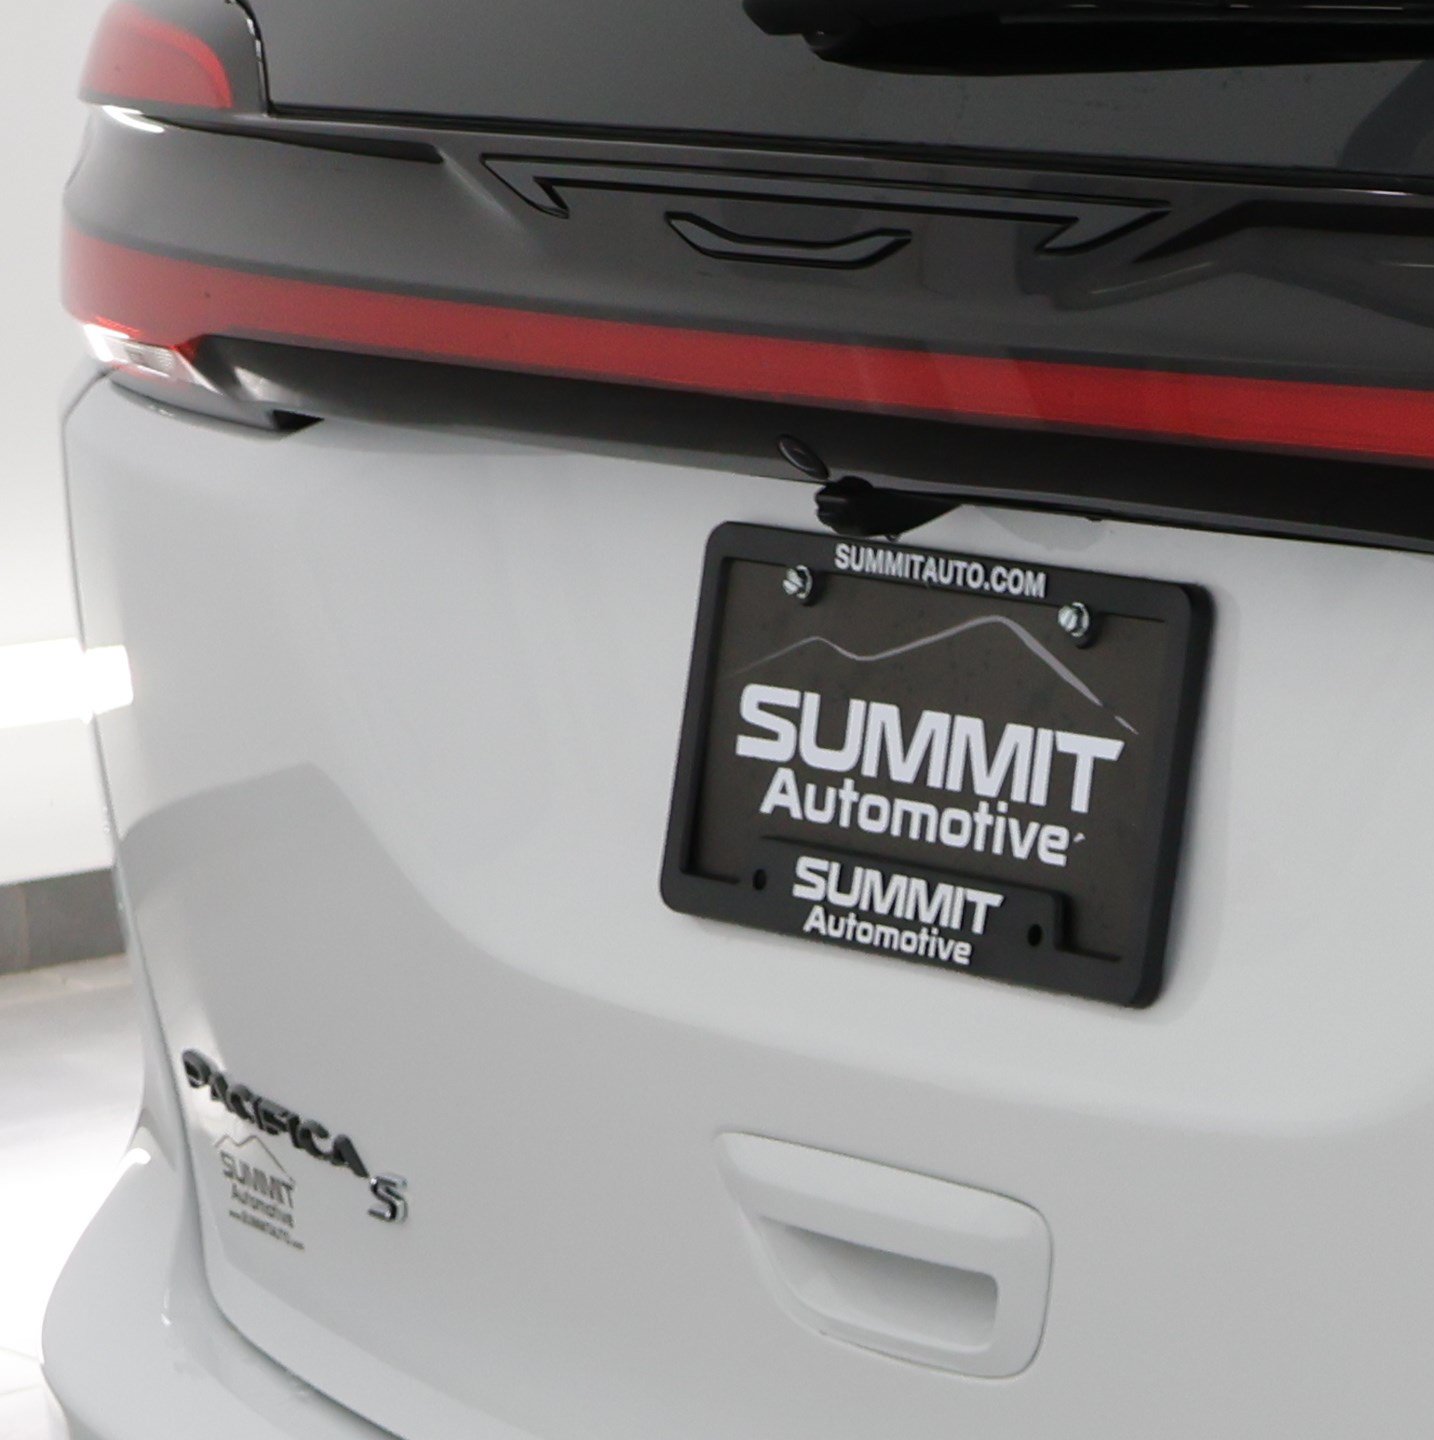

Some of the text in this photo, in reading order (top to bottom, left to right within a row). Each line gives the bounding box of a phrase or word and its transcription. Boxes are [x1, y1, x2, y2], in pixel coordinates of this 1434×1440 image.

[834, 542, 1046, 598] SUMMITAUTO.COM
[735, 683, 1125, 813] SUMMIT
[759, 767, 1070, 867] Automotive
[792, 855, 1004, 935] SUMMIT
[803, 905, 973, 965] Automotive
[367, 1175, 408, 1224] S
